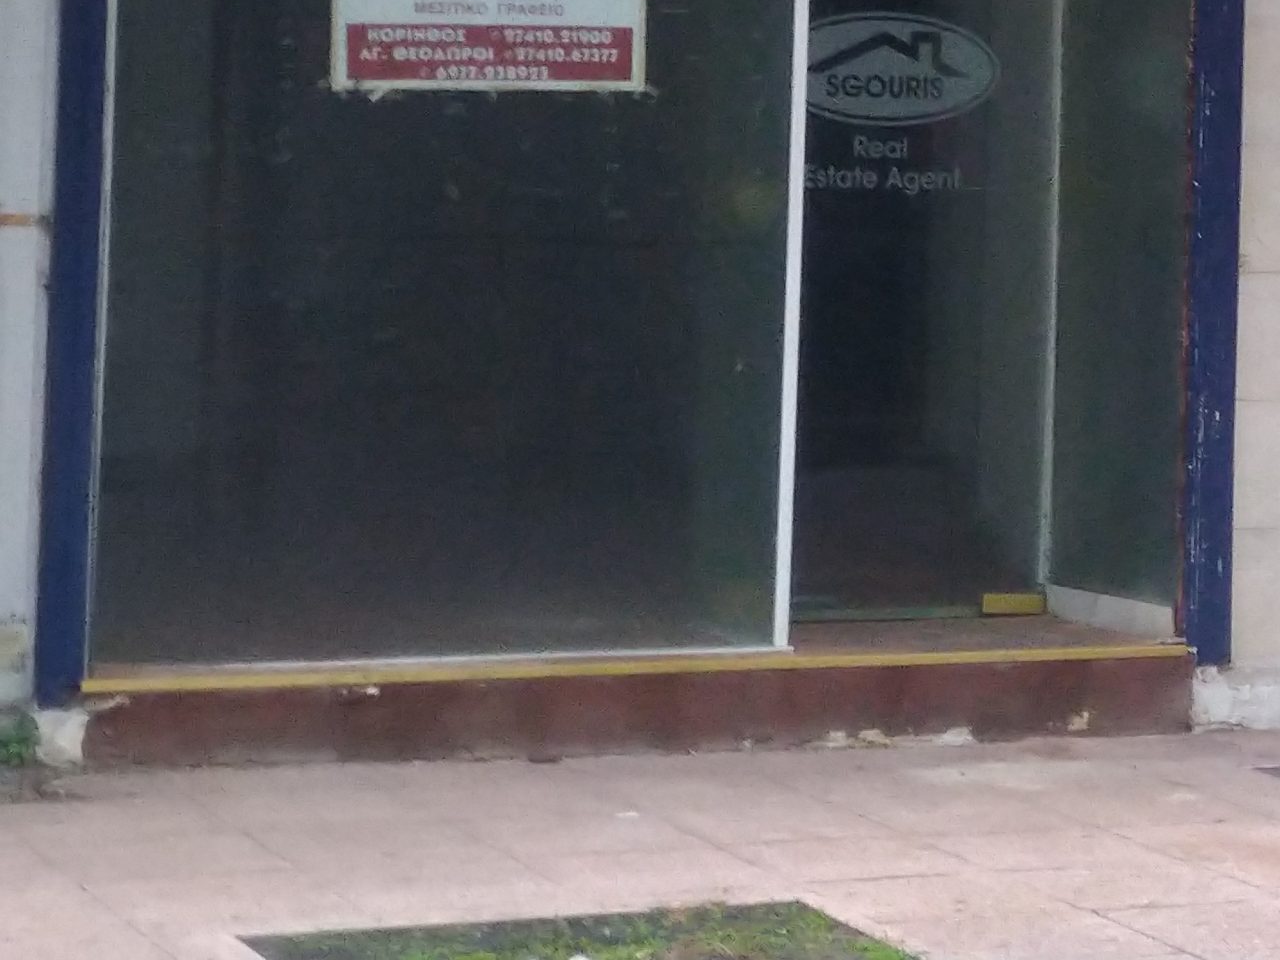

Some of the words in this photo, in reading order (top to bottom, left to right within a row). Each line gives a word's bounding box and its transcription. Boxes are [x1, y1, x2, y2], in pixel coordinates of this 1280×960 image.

[498, 3, 564, 17] ΓΡΑΦΕΙΟ
[367, 27, 467, 43] ΚΟΡΙΝΘΟΣ
[825, 73, 944, 100] SGOURIS
[853, 135, 908, 159] Real
[804, 163, 878, 190] Estate
[886, 166, 960, 195] Agent
